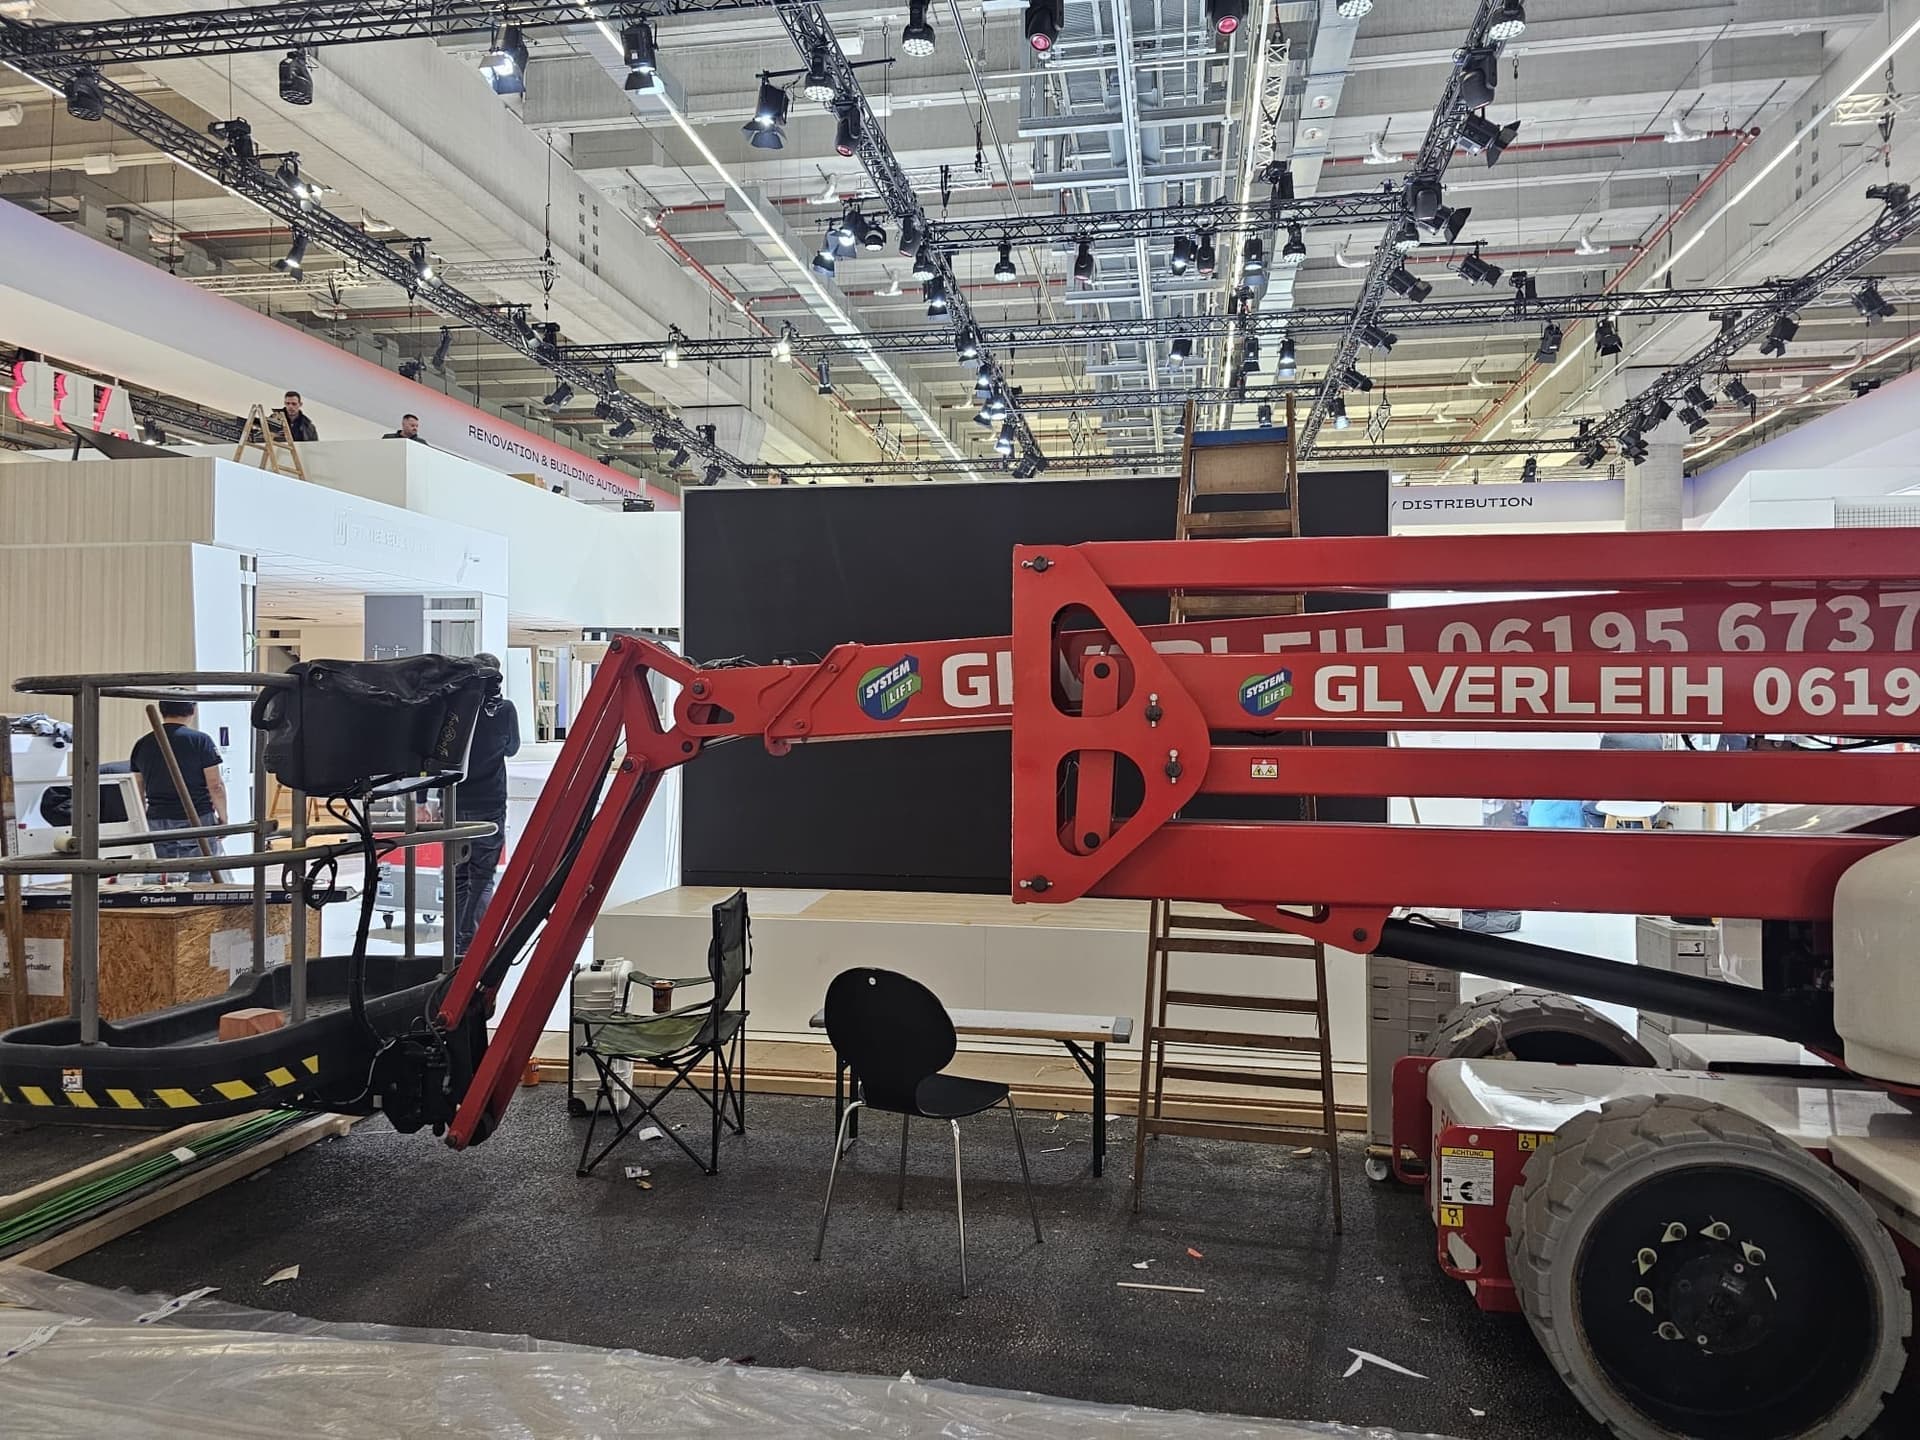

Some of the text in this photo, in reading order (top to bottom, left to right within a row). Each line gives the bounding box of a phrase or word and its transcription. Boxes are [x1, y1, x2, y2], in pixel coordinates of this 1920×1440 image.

[468, 425, 540, 463] RENOVATION
[541, 456, 549, 467] &
[550, 458, 595, 484] BUILDING
[1402, 497, 1533, 510] DISTRIBUTION
[866, 660, 911, 699] SYSTEM
[889, 679, 913, 704] LIFT
[1246, 671, 1285, 699] SYSTEM
[1314, 665, 1403, 713] GL
[1408, 666, 1723, 715] VERLEIH
[1264, 687, 1287, 704] LIFT
[149, 896, 177, 904] Tarkett
[1451, 1149, 1485, 1158] ACHTUNG
